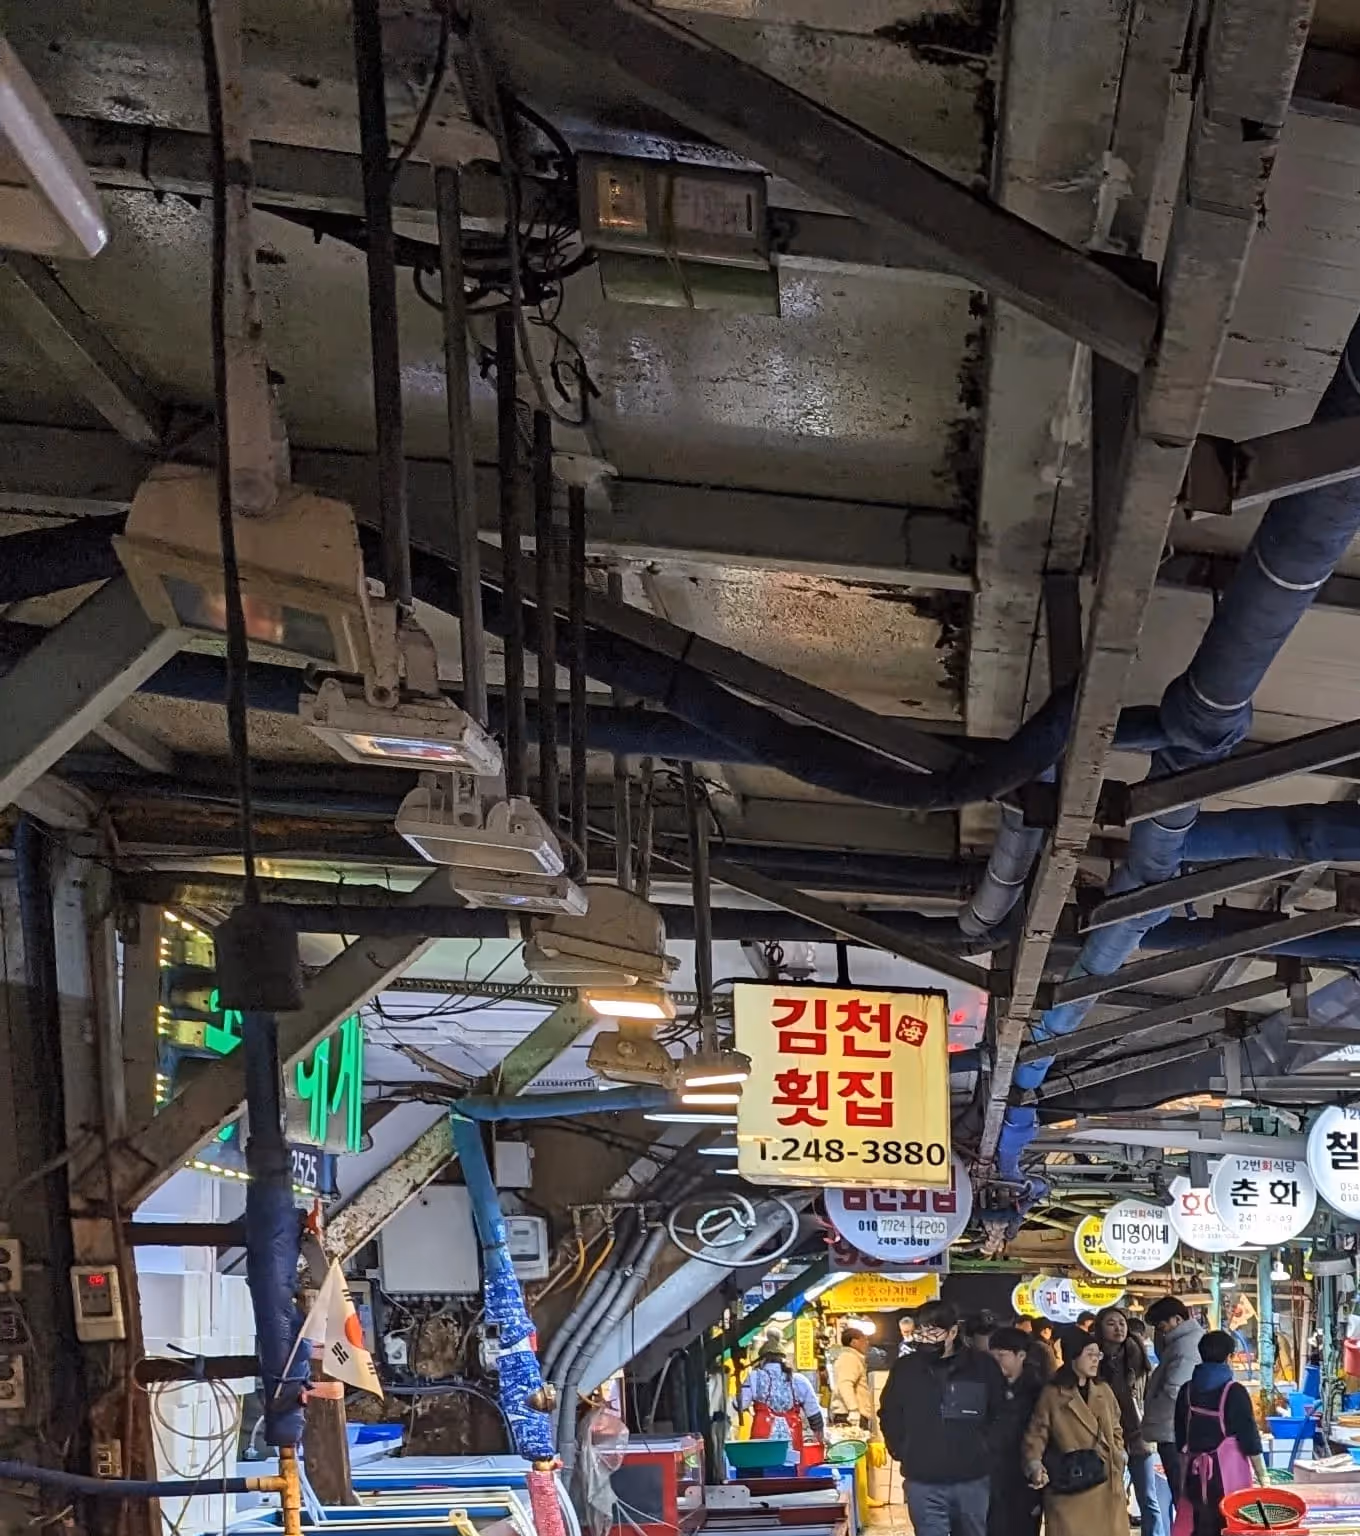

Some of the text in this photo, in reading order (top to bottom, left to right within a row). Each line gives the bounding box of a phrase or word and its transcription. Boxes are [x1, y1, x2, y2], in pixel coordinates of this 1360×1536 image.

[772, 998, 892, 1059] 김천
[771, 1067, 895, 1128] 횟집
[758, 1138, 945, 1167] T.248-3880
[1236, 1160, 1296, 1174] 12번회식당
[1112, 1223, 1169, 1244] 미영이네
